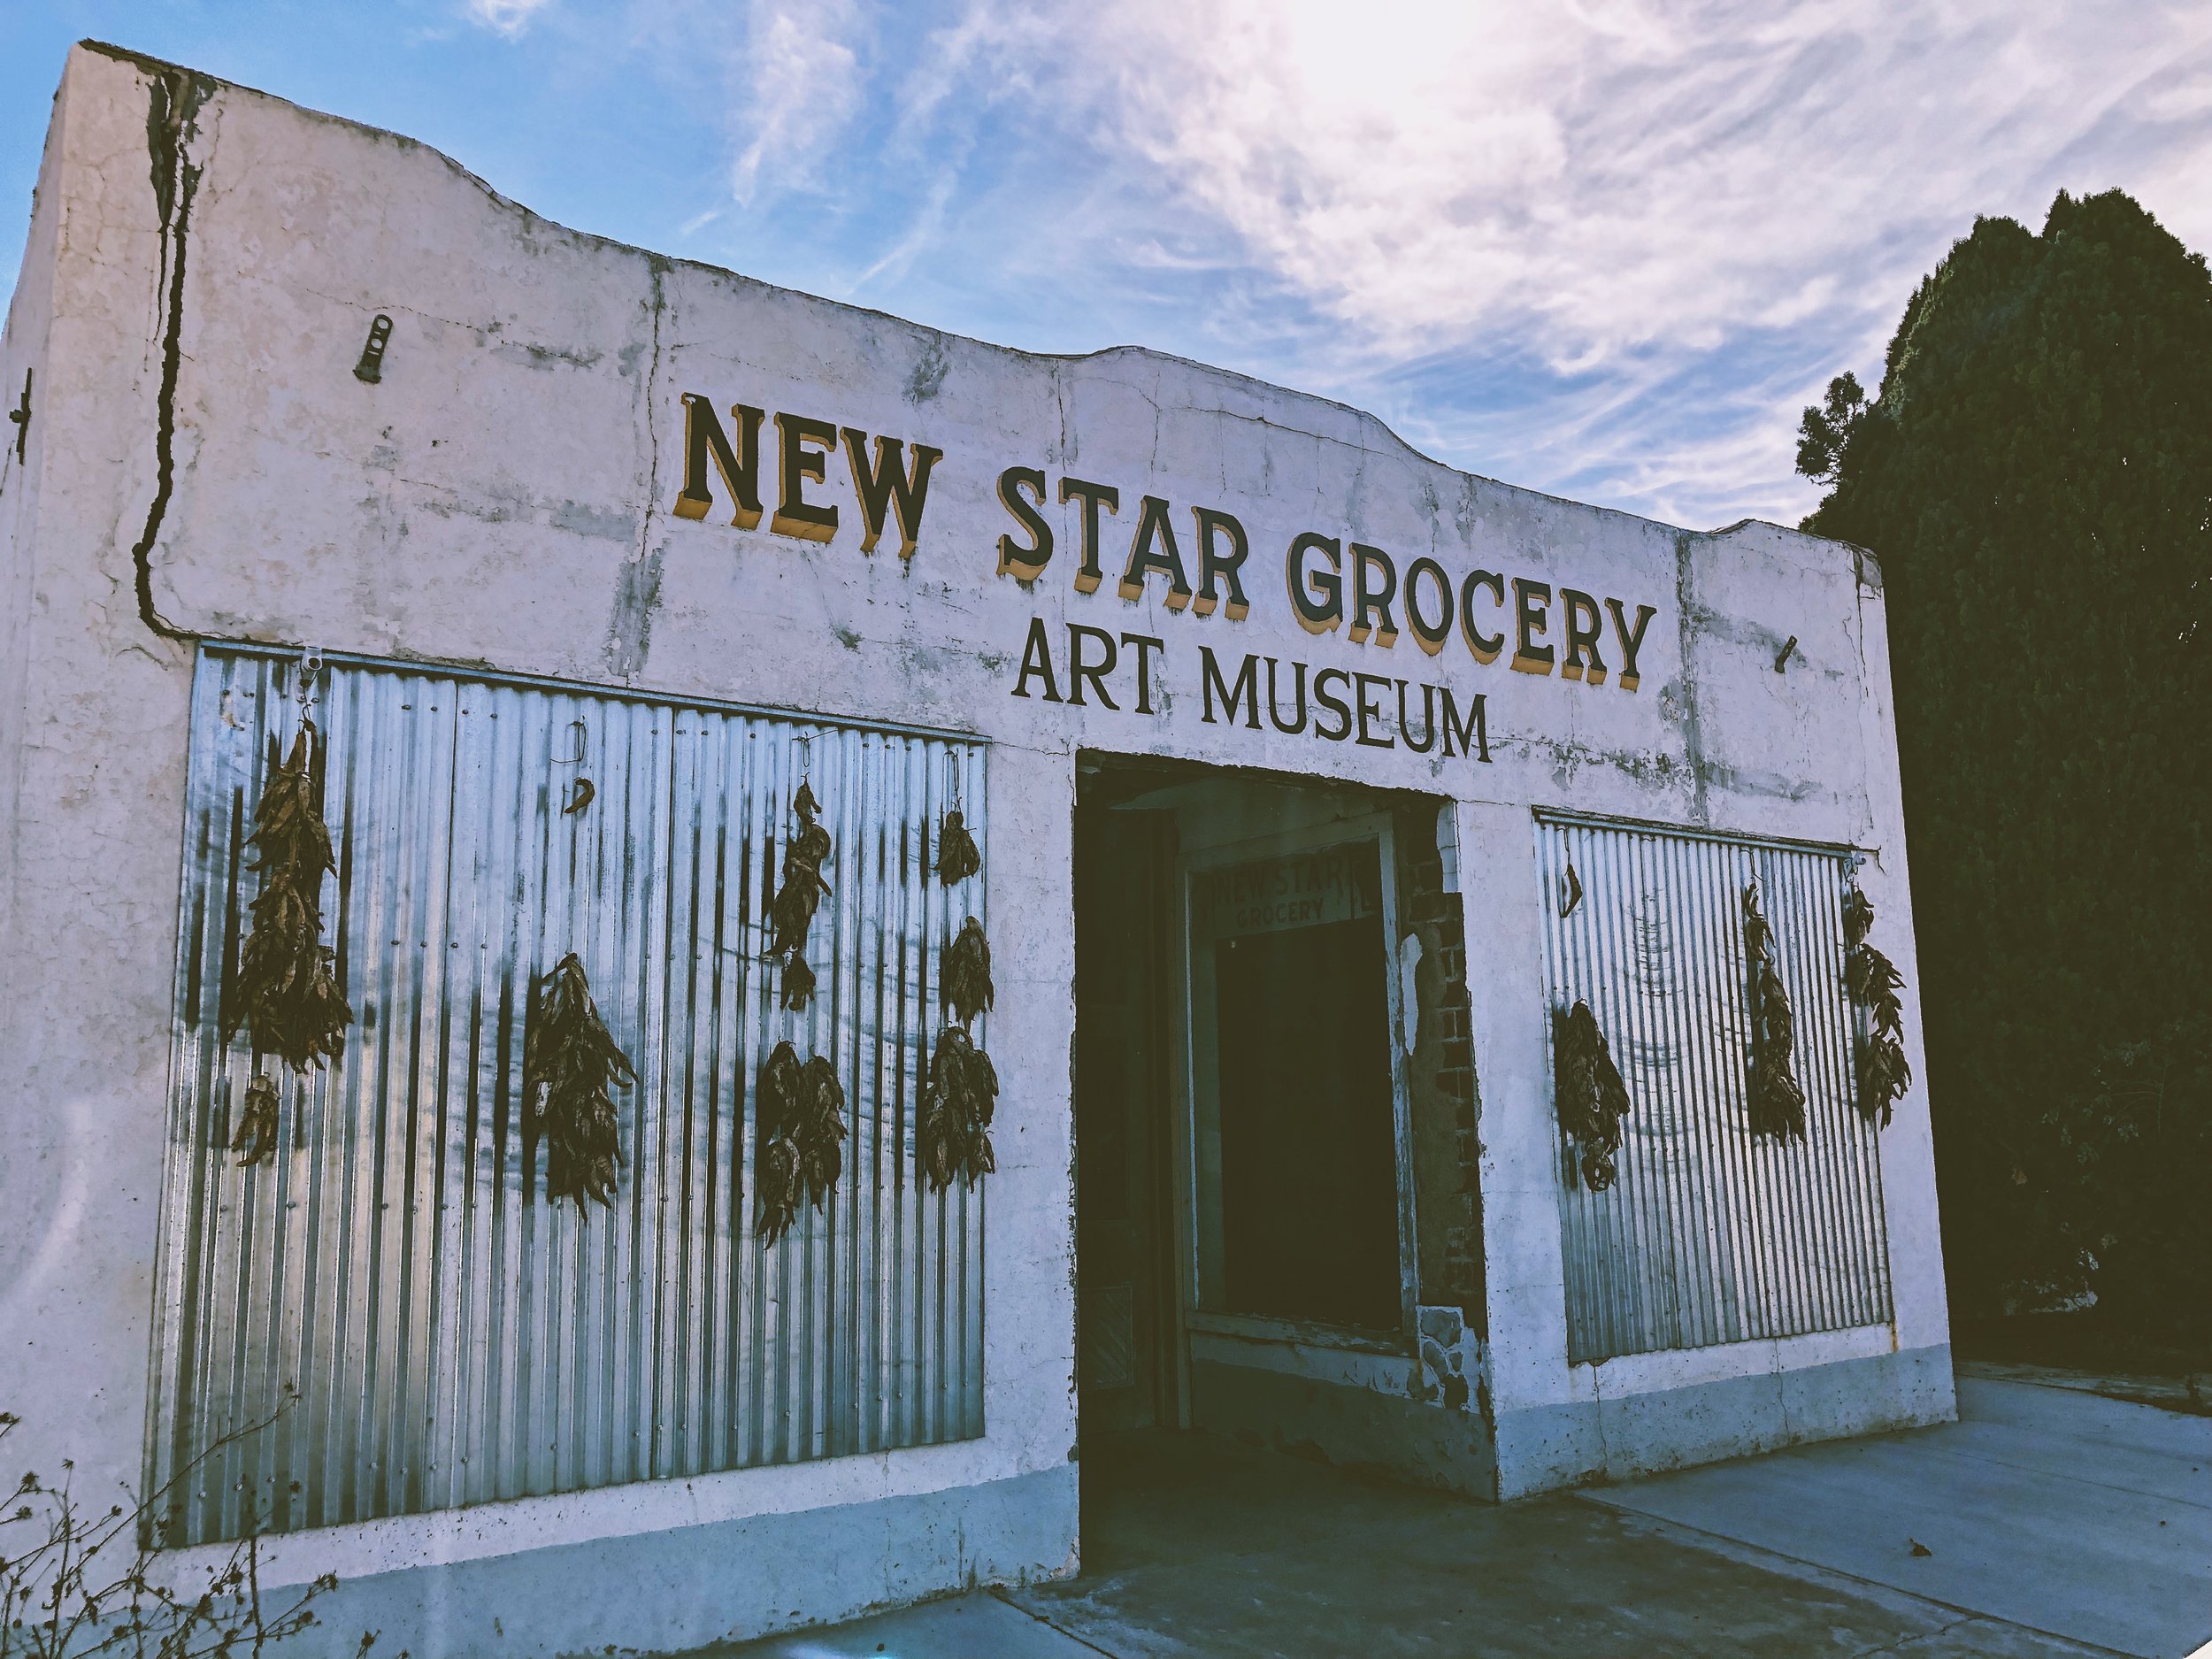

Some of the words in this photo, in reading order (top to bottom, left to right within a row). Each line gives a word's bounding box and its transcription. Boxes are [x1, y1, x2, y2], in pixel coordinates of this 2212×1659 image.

[673, 392, 943, 559] NEW
[996, 466, 1249, 621] STAR
[1286, 532, 1657, 693] GROCERY
[1010, 617, 1164, 715] ART
[1198, 645, 1493, 763] MUSEUM
[1217, 866, 1265, 904] NEW
[1275, 854, 1344, 897] STAR
[1236, 897, 1324, 929] GROCERY
